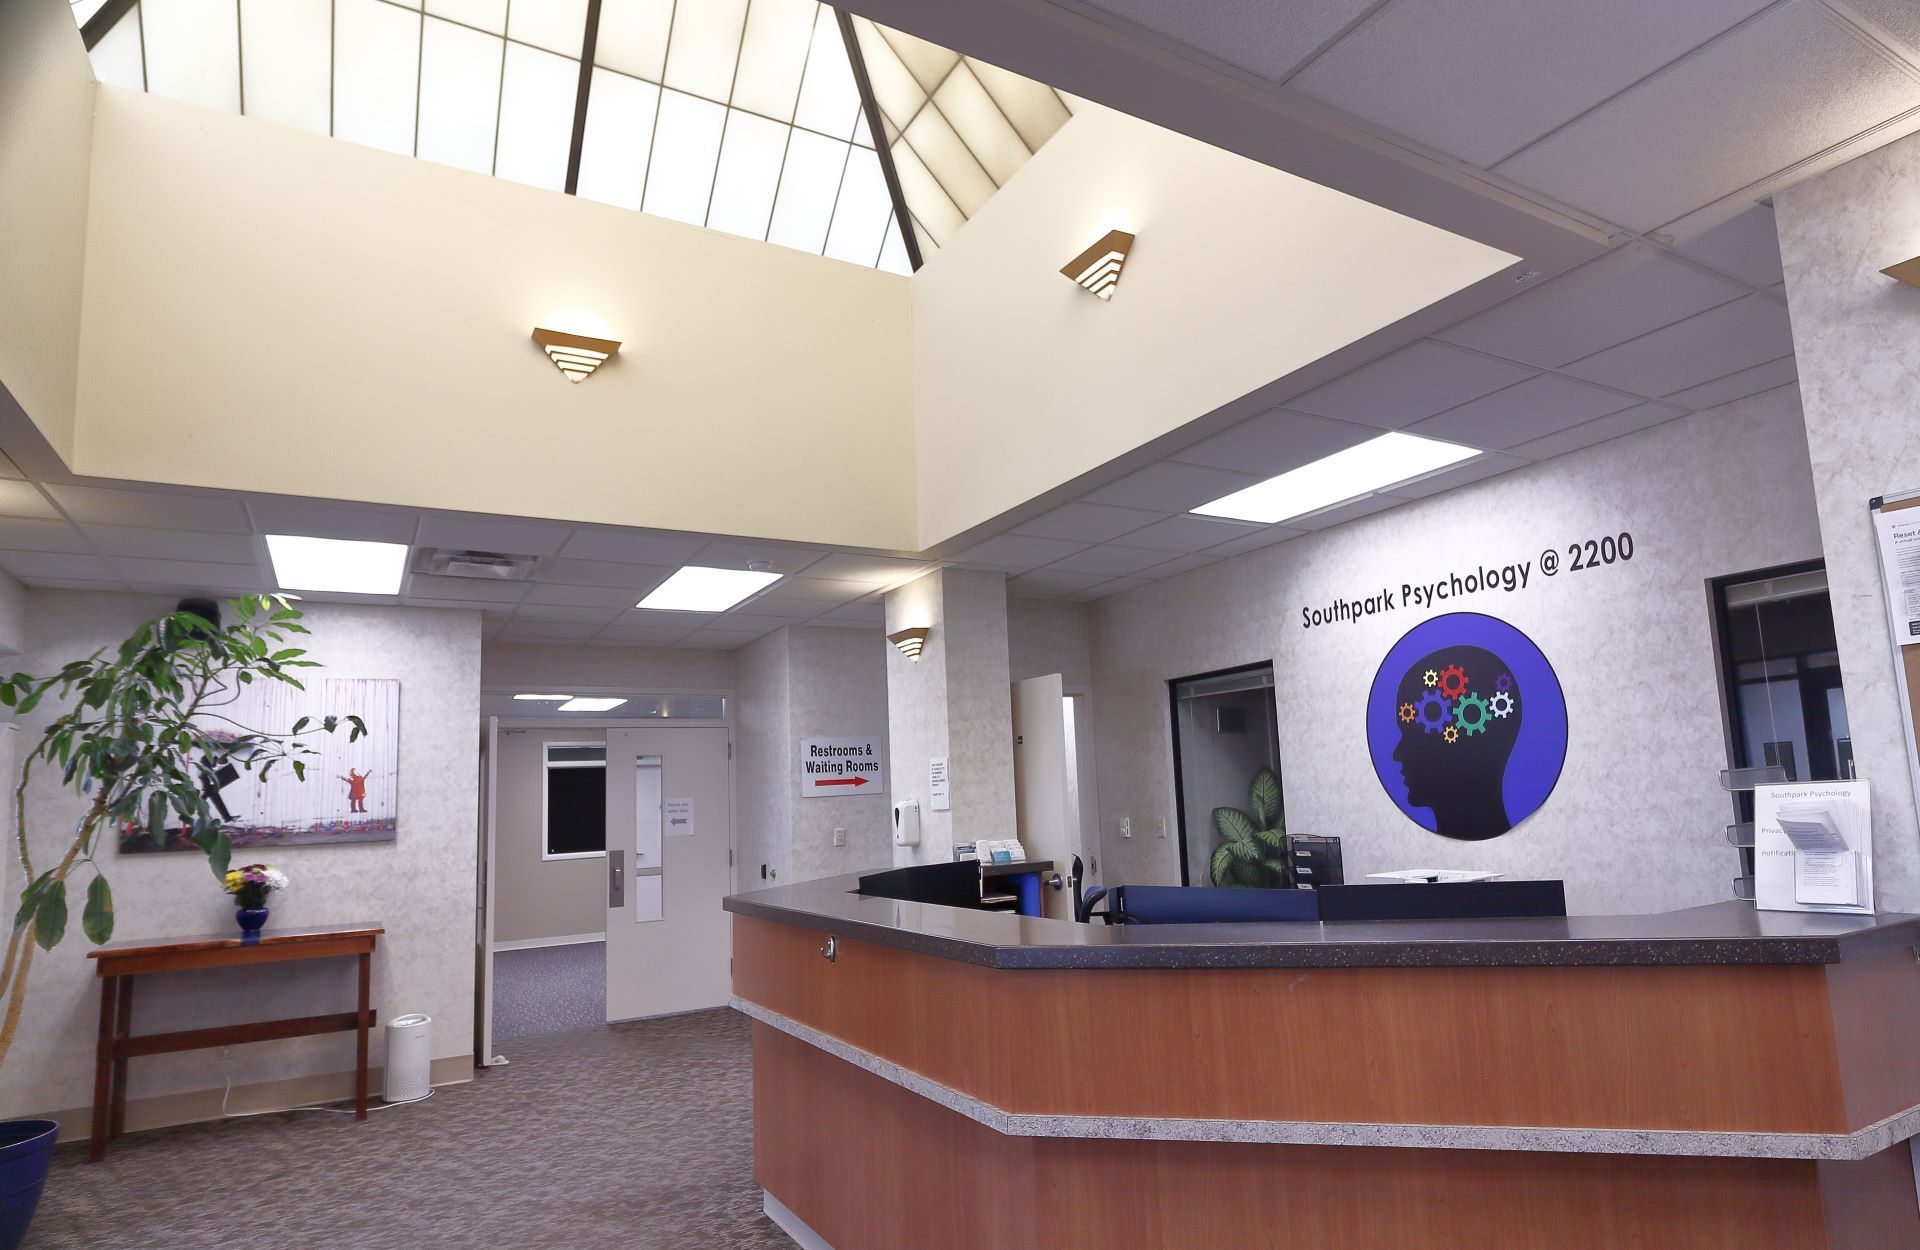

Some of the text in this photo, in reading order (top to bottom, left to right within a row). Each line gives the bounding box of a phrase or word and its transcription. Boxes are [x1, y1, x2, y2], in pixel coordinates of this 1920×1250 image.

[1893, 531, 1915, 539] Reset
[1302, 532, 1634, 629] Southpark Psychology @ 2200
[810, 743, 873, 757] Restrooms &
[805, 760, 879, 775] Waiting Rooms
[1771, 789, 1852, 799] Southpark Psychology
